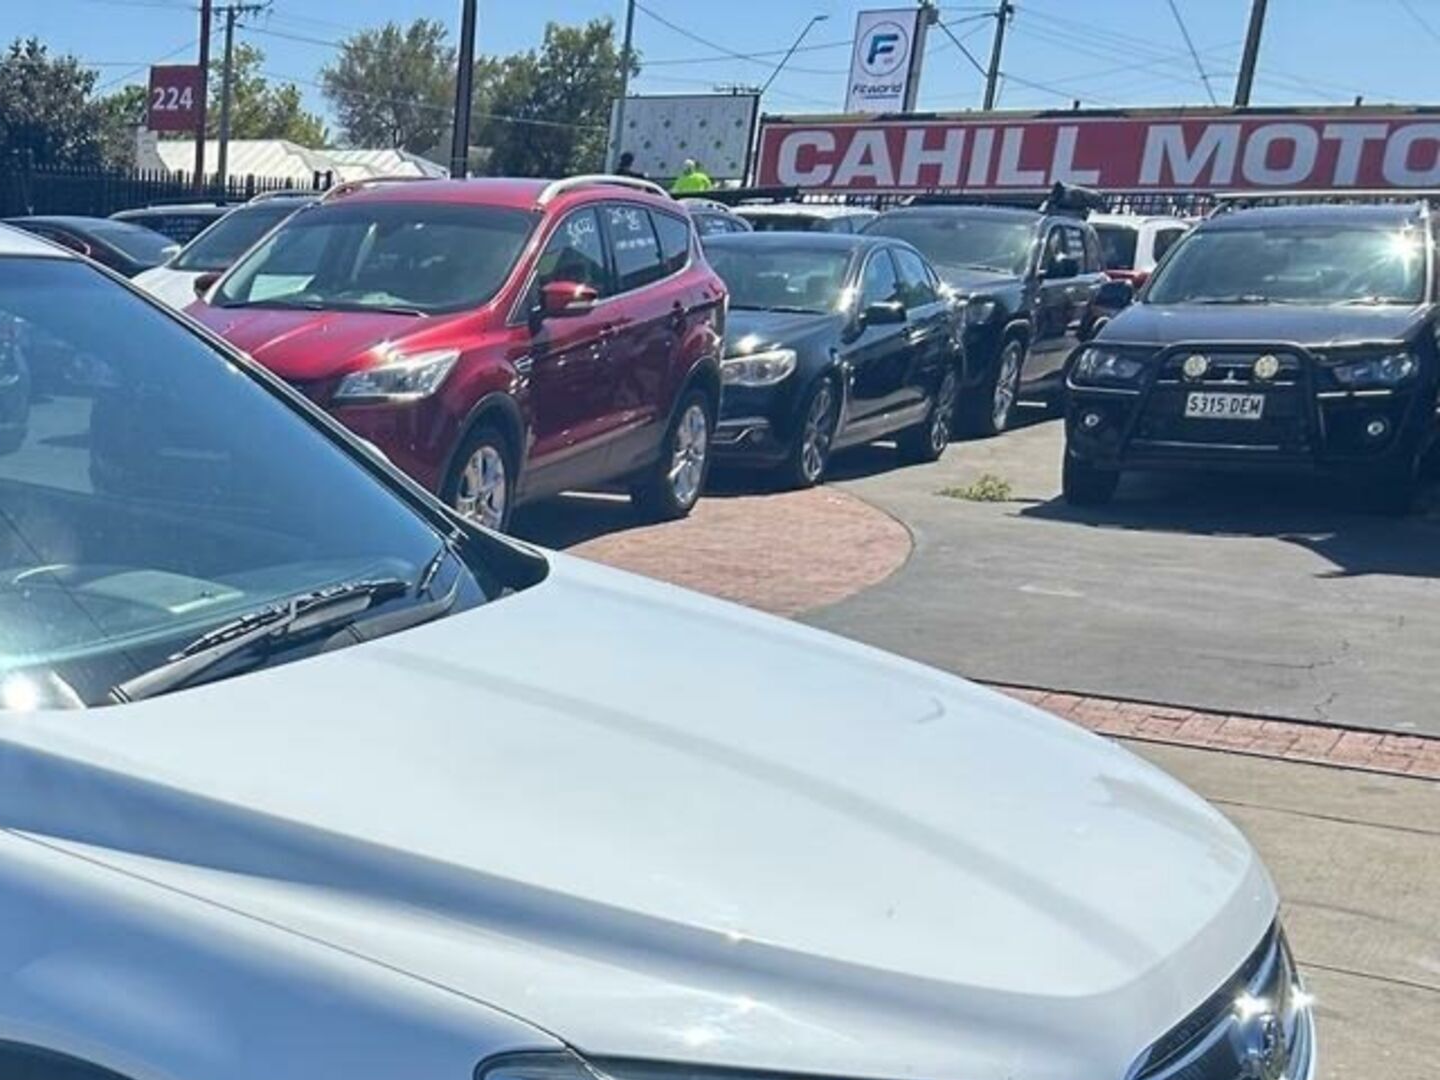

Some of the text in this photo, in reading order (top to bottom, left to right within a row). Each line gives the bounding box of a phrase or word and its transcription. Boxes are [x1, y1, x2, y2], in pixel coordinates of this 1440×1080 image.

[152, 86, 194, 110] 224
[776, 123, 1440, 187] CAHILL MOTO
[1189, 396, 1225, 413] S315
